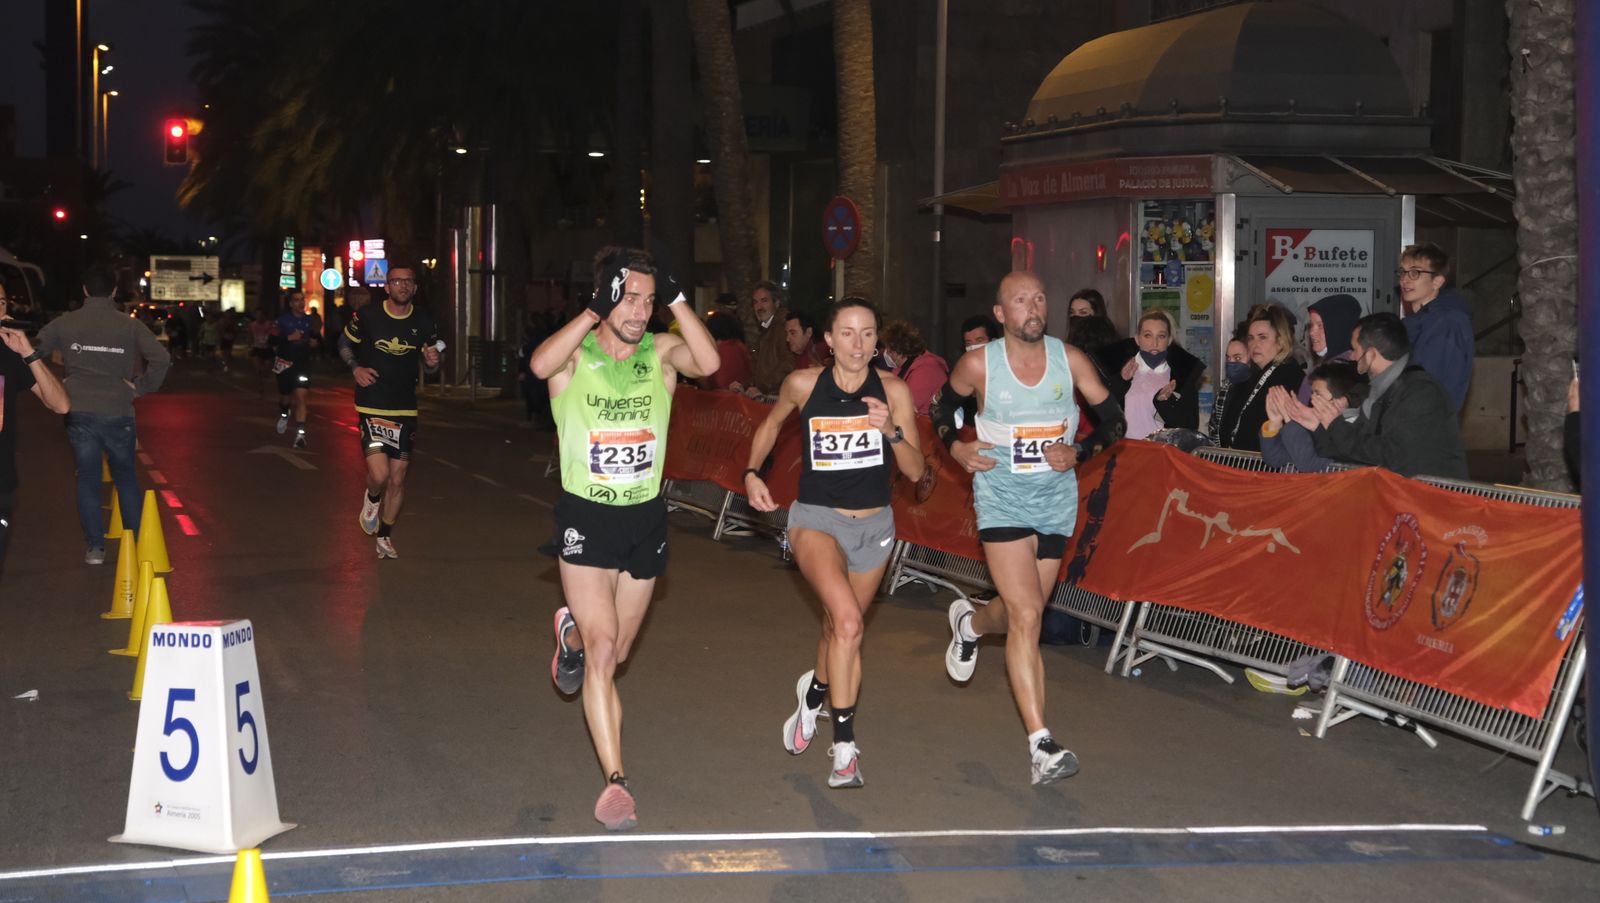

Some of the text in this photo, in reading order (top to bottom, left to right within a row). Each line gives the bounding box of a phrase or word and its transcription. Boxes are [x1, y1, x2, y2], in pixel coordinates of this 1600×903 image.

[1020, 175, 1040, 197] Voz
[1043, 174, 1057, 195] de
[1119, 177, 1209, 190] PALACIO DE JUSTICIA
[1303, 246, 1369, 261] Bufete
[1291, 274, 1338, 284] Queremos
[586, 394, 652, 410] Universo
[597, 408, 651, 422] Running
[376, 425, 394, 439] 410
[824, 431, 871, 452] 374
[603, 444, 647, 465] 235
[152, 632, 212, 649] MONDO
[222, 626, 252, 649] MONDO
[159, 687, 200, 783] 5
[235, 680, 259, 776] 5
